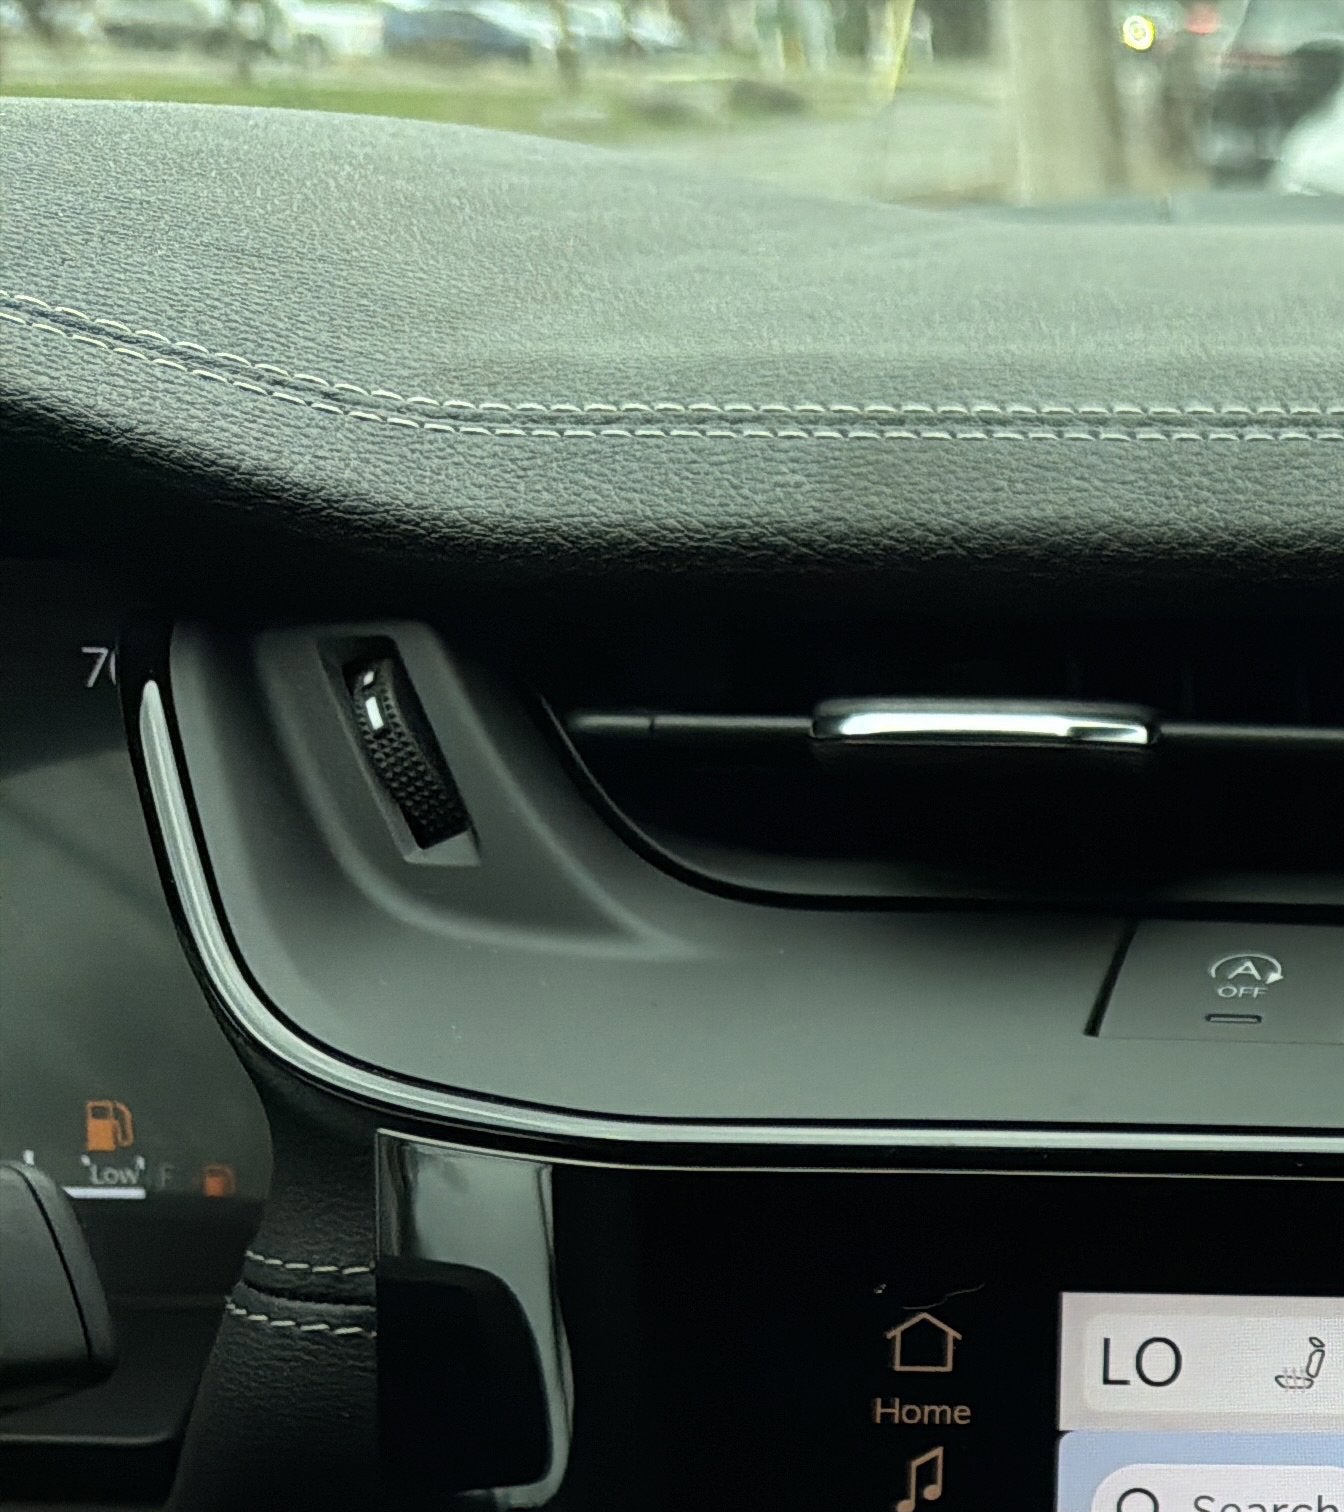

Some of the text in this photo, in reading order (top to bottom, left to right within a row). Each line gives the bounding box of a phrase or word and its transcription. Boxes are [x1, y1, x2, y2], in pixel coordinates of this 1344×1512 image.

[1215, 983, 1268, 999] OFF
[89, 1164, 140, 1185] LOW
[1101, 1336, 1183, 1388] LO
[874, 1397, 972, 1425] Home
